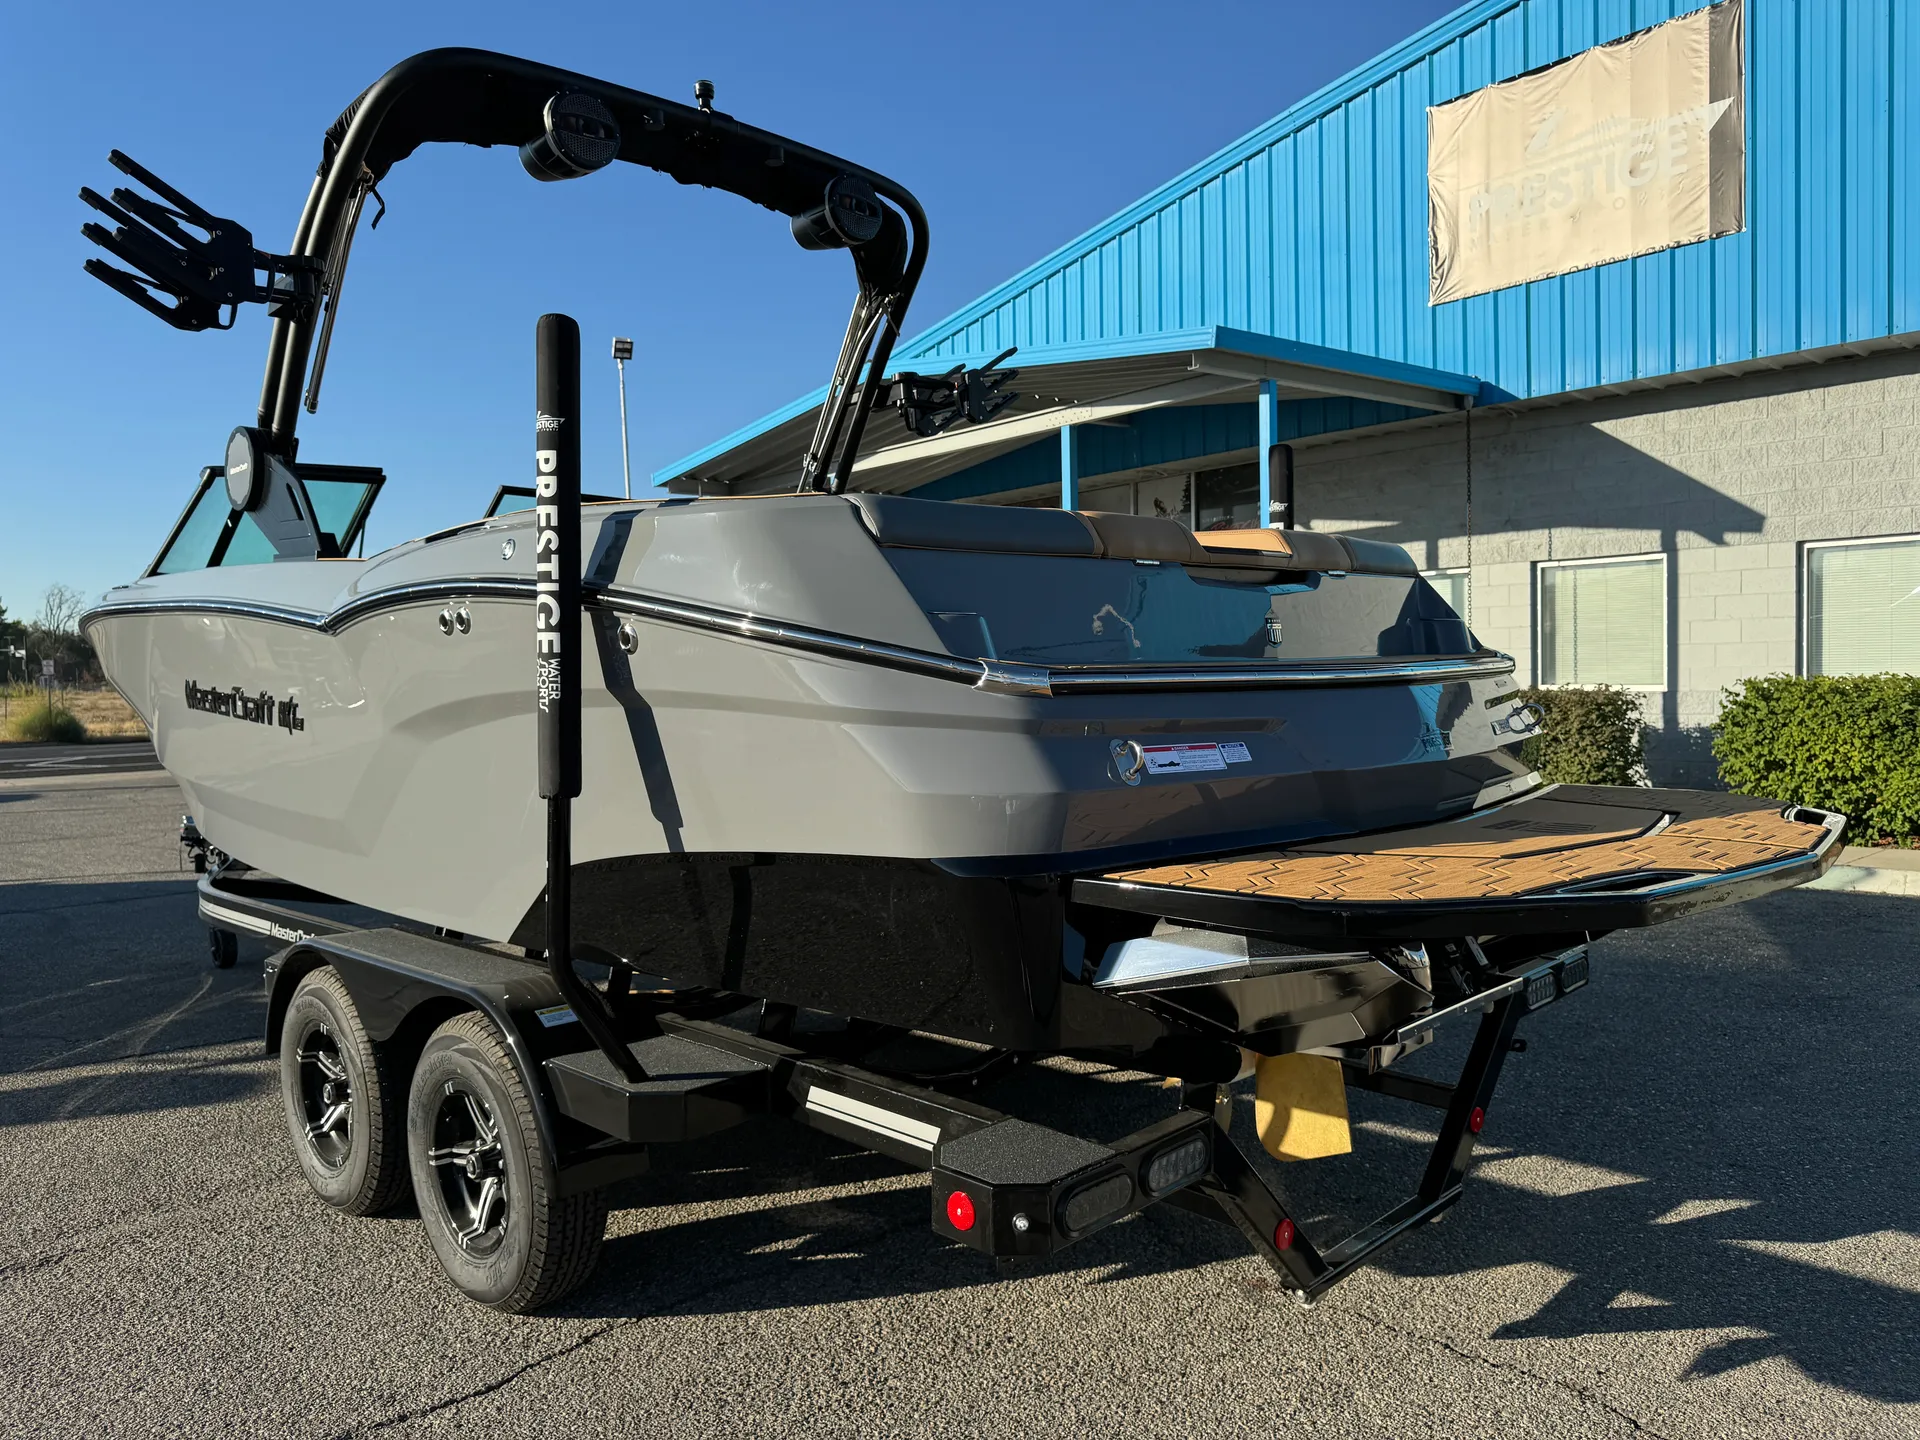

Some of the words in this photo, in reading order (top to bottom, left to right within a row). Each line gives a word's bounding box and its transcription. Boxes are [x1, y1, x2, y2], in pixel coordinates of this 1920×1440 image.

[1469, 119, 1690, 233] PRESTIGE
[536, 449, 561, 653] PRESTIGE
[539, 657, 549, 713] SPORTS
[548, 658, 561, 700] WATER
[271, 922, 316, 943] MasterC
